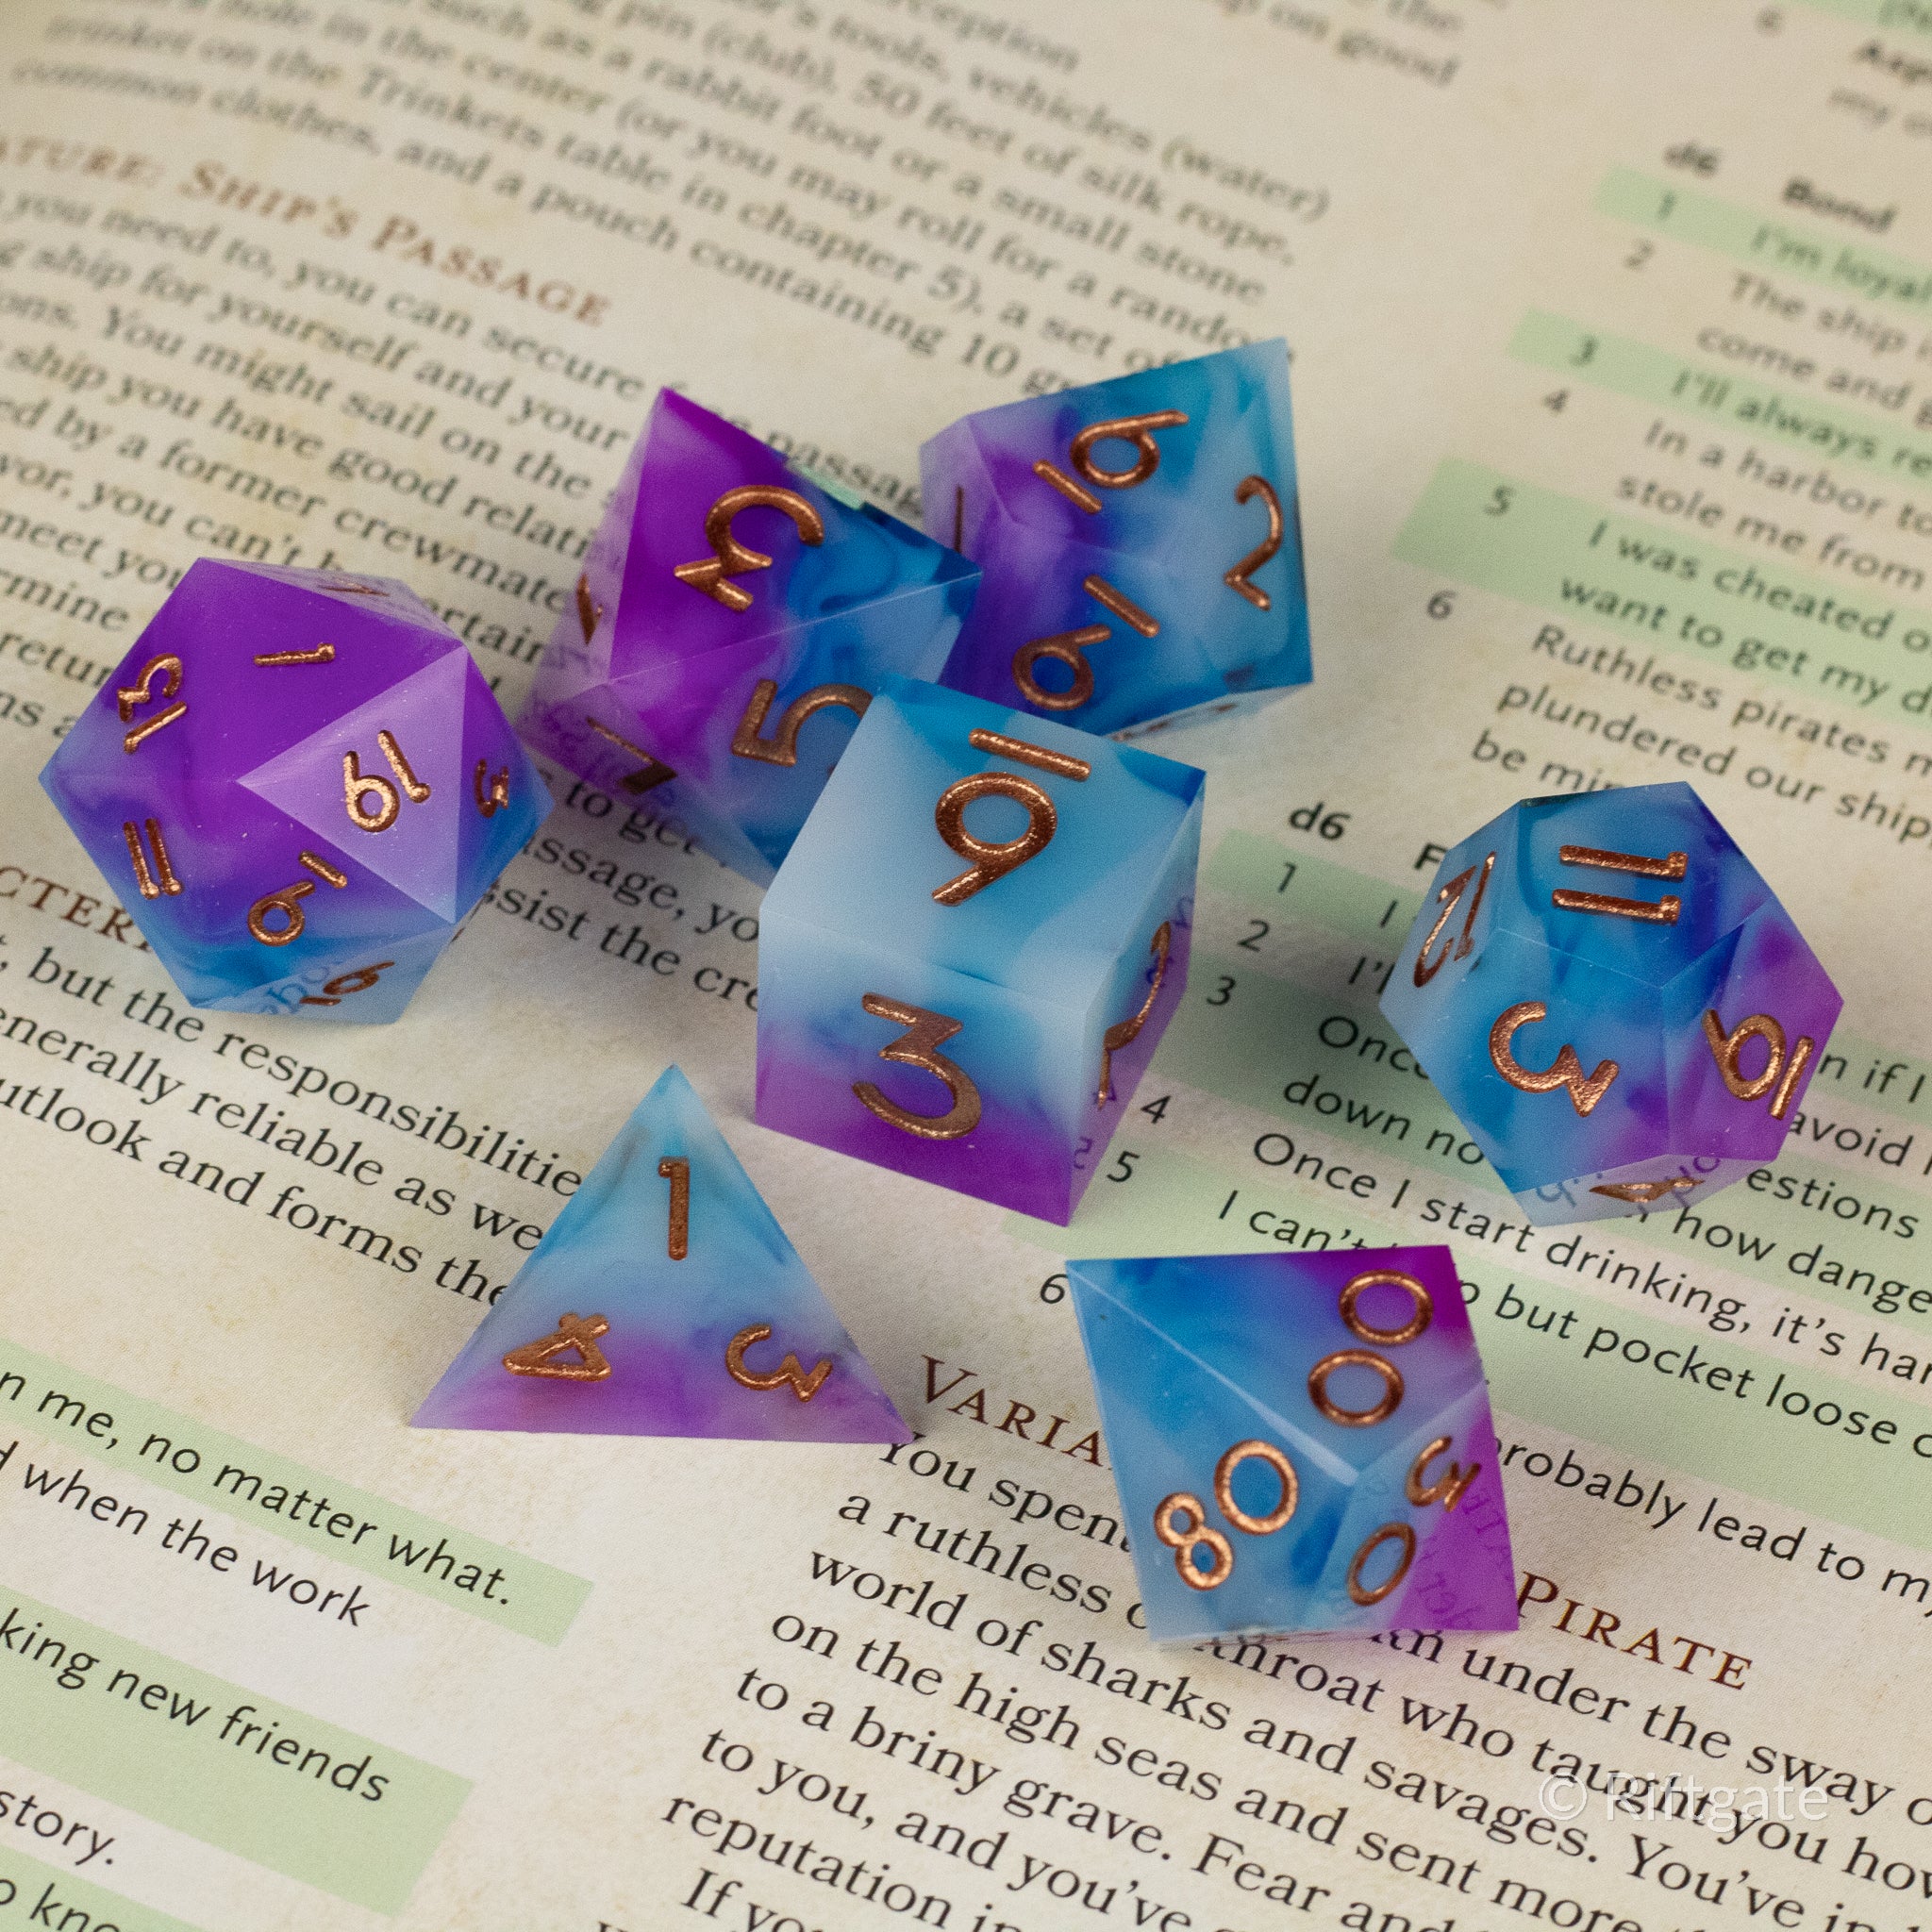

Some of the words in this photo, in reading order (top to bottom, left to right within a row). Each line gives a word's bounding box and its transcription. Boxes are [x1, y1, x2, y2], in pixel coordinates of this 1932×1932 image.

[529, 185, 679, 252] pouch
[690, 241, 946, 358] containing
[959, 333, 1021, 377] 10
[739, 203, 921, 283] chapter
[138, 264, 211, 308] for
[205, 291, 422, 373] yourself
[414, 362, 514, 408] and
[507, 395, 629, 451] your
[282, 258, 379, 307] you
[386, 294, 473, 338] can
[484, 327, 644, 396] secure
[1731, 271, 1806, 320] The
[1818, 308, 1909, 358] ship
[102, 302, 187, 358] You
[193, 343, 336, 405] might
[342, 393, 437, 439] sail
[440, 429, 501, 466] on
[513, 452, 592, 497] the
[106, 375, 203, 419] you
[210, 397, 324, 457] have
[327, 450, 459, 508] good
[1541, 388, 1571, 417] 4
[1644, 419, 1689, 456] In
[1699, 445, 1725, 469] a
[1737, 448, 1886, 518] harbor
[1569, 334, 1600, 368] 3
[1736, 397, 1876, 459] always
[54, 406, 112, 446] by
[117, 435, 148, 460] a
[158, 440, 327, 518] former
[77, 480, 176, 529] you
[674, 484, 825, 612] 3
[1225, 475, 1285, 611] 2
[1482, 484, 1517, 518] 5
[1588, 520, 1608, 548] I
[1618, 537, 1699, 580] was
[1713, 567, 1895, 641] cheated
[1616, 476, 1724, 527] stole
[1735, 516, 1807, 553] me
[1819, 534, 1925, 591] from
[1425, 590, 1458, 621] 6
[1531, 624, 1722, 710] Ruthless
[1731, 699, 1889, 763] pirates
[1560, 577, 1668, 631] want
[1679, 614, 1724, 648] to
[1731, 639, 1809, 676] get
[1820, 664, 1890, 707] my
[1495, 684, 1738, 776] plundered
[1287, 801, 1352, 841] d6
[1236, 918, 1271, 953] 2
[1277, 861, 1298, 894] 1
[1378, 899, 1399, 929] I
[1552, 844, 1690, 927] 11
[27, 945, 115, 1007] but
[122, 990, 205, 1042] the
[599, 924, 681, 976] the
[851, 991, 983, 1141] 3
[1206, 974, 1238, 1008] 3
[1862, 1059, 1908, 1094] if
[1907, 1074, 1926, 1105] I
[1489, 1000, 1621, 1119] 3
[188, 1091, 384, 1187] reliable
[393, 1176, 457, 1216] as
[1283, 1074, 1411, 1141] down
[158, 1150, 266, 1208] and
[266, 1185, 424, 1274] forms
[658, 1155, 691, 1262] 1
[1106, 1150, 1141, 1184] 5
[1218, 1189, 1239, 1221] I
[1140, 1093, 1173, 1125] 4
[1253, 1132, 1377, 1199] Once
[1391, 1178, 1411, 1209] I
[1420, 1198, 1535, 1254] start
[1545, 1234, 1751, 1334] drinking,
[1772, 1307, 1846, 1357] it's
[1673, 1205, 1778, 1262] how
[502, 1312, 612, 1383] 4
[1038, 1273, 1070, 1306] 6
[724, 1324, 835, 1404] 3
[922, 1354, 1103, 1468] VARIA
[1494, 1282, 1579, 1340] but
[1583, 1326, 1756, 1399] pocket
[1765, 1373, 1898, 1445] loose
[23, 1462, 149, 1536] when
[160, 1518, 239, 1573] the
[251, 1559, 370, 1627] work
[36, 1390, 119, 1450] me,
[138, 1433, 202, 1474] no
[212, 1464, 378, 1545] matter
[388, 1534, 508, 1606] what.
[1697, 1497, 1807, 1562] lead
[1816, 1541, 1866, 1581] to
[838, 1495, 872, 1525] a
[882, 1511, 1112, 1614] ruthless
[1401, 1696, 1515, 1757] who
[1530, 1739, 1713, 1827] taught
[1715, 1807, 1830, 1866] you
[1515, 1570, 1754, 1692] PIRATE
[106, 1669, 212, 1727] new
[218, 1705, 391, 1802] friends
[736, 1667, 790, 1711] to
[801, 1700, 835, 1732] a
[849, 1705, 1002, 1796] briny
[1002, 1778, 1172, 1861] grave.
[1191, 1832, 1332, 1913] Fear
[771, 1614, 840, 1659] on
[855, 1639, 943, 1696] the
[953, 1671, 1081, 1751] high
[1093, 1736, 1223, 1801] seas
[1234, 1789, 1350, 1847] and
[1356, 1831, 1481, 1894] sent
[1490, 1878, 1643, 1932] more
[811, 1550, 969, 1632] world
[974, 1619, 1044, 1657] of
[1040, 1641, 1231, 1731] sharks
[1242, 1718, 1357, 1776] and
[1363, 1760, 1598, 1864] savages.
[1626, 1833, 1806, 1929] You've
[1461, 1649, 1631, 1724] under
[1641, 1704, 1732, 1759] the
[1745, 1745, 1895, 1817] sway
[660, 1797, 953, 1930] reputation
[680, 1867, 744, 1919] If
[701, 1729, 755, 1774] to
[756, 1758, 875, 1830] you,
[894, 1811, 1010, 1872] and
[1005, 1854, 1192, 1932] you've
